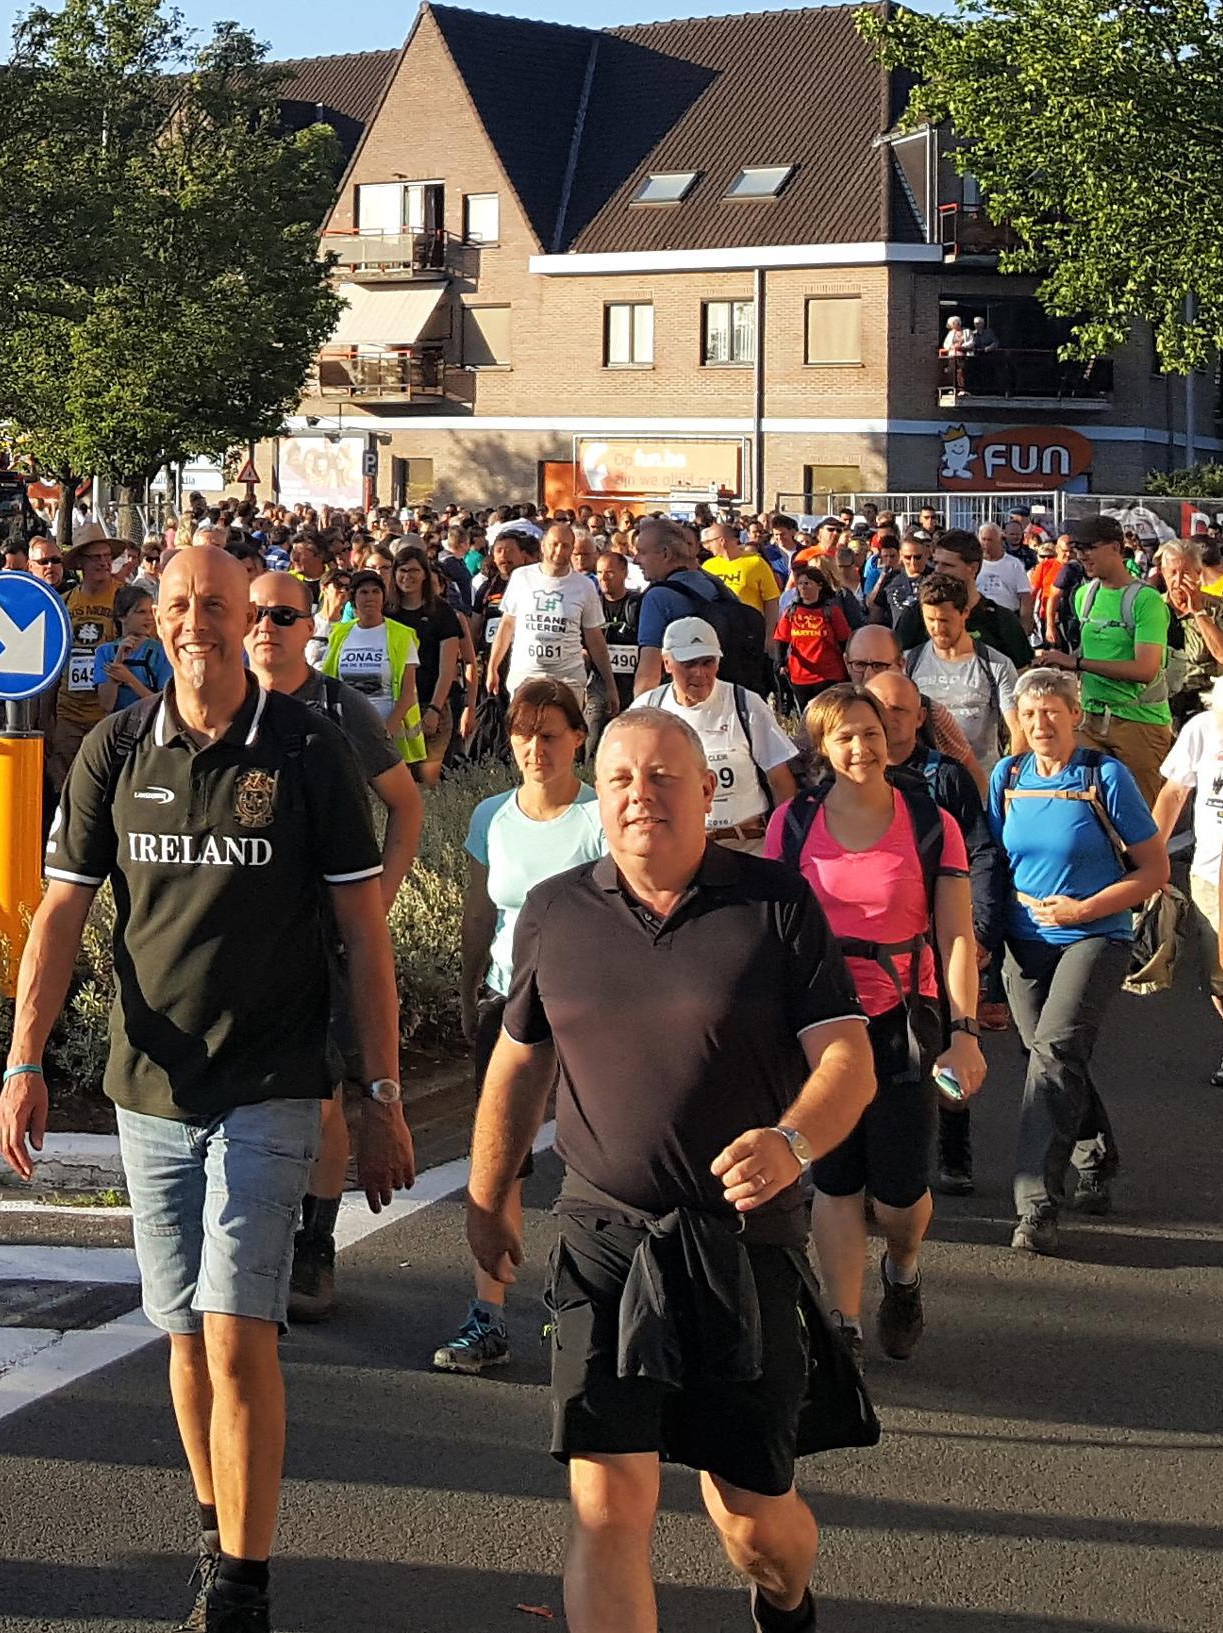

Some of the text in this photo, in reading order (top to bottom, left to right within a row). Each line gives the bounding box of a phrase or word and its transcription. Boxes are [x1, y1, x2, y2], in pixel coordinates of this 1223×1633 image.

[983, 444, 1070, 478] FUN
[528, 645, 561, 658] 6061
[127, 832, 273, 866] IRELAND
